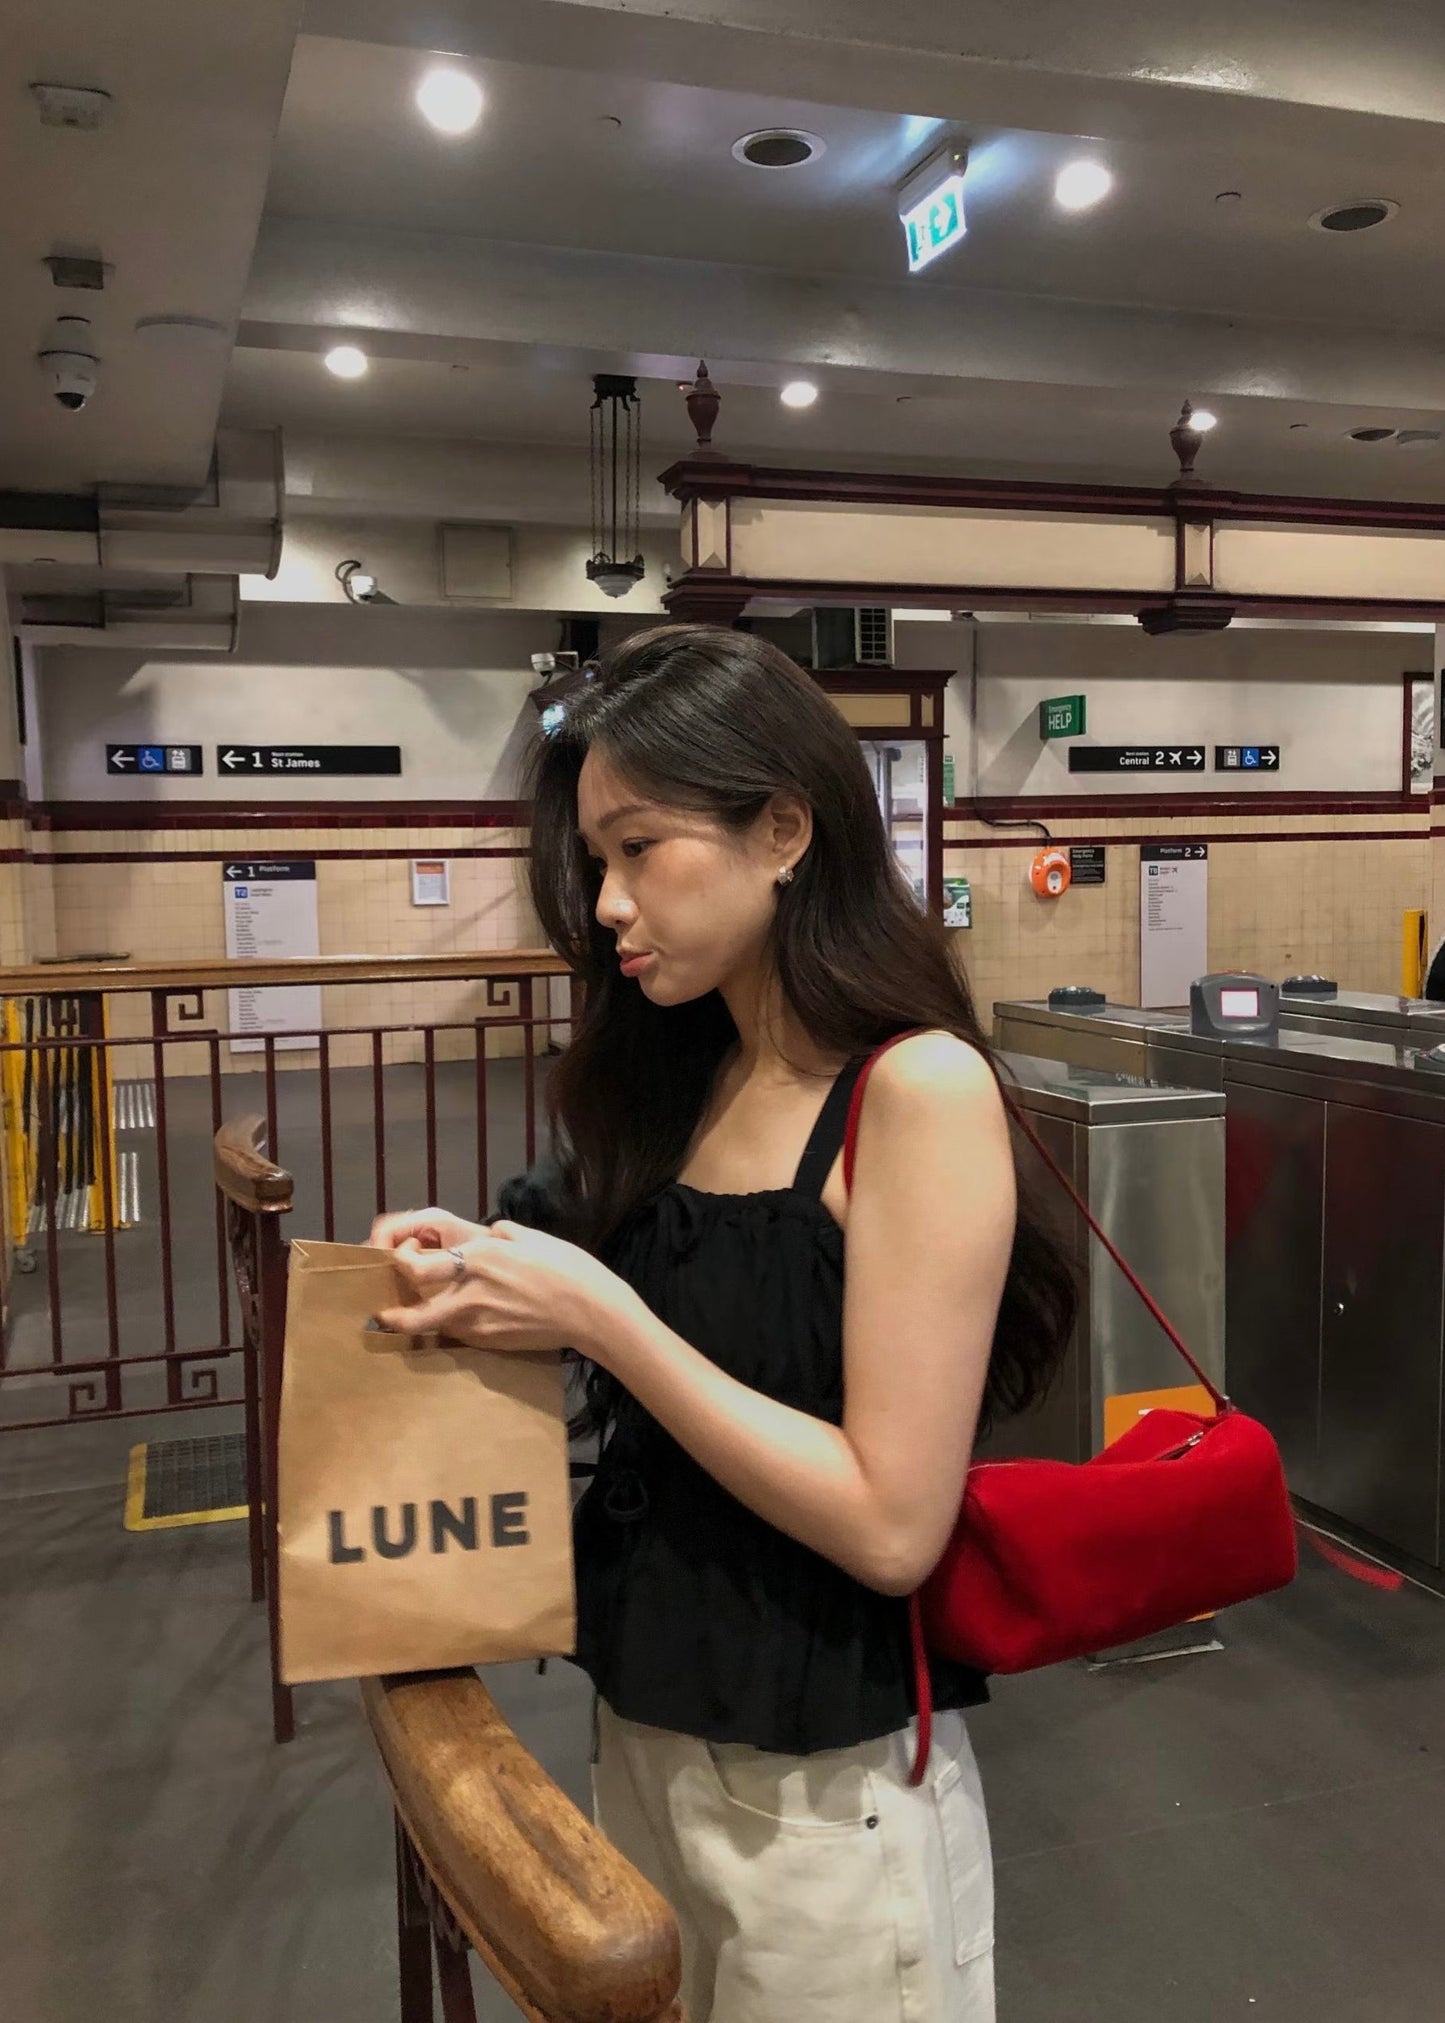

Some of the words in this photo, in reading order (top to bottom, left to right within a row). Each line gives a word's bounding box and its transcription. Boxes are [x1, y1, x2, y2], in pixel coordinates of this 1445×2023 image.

[1048, 712, 1072, 730] HELP
[252, 752, 263, 768] 1
[271, 758, 283, 768] St
[285, 758, 321, 768] James
[1119, 757, 1150, 765] Central
[1155, 751, 1165, 765] 2
[1184, 847, 1192, 857] 2
[248, 866, 255, 877] 1
[329, 1491, 530, 1564] LUNE
